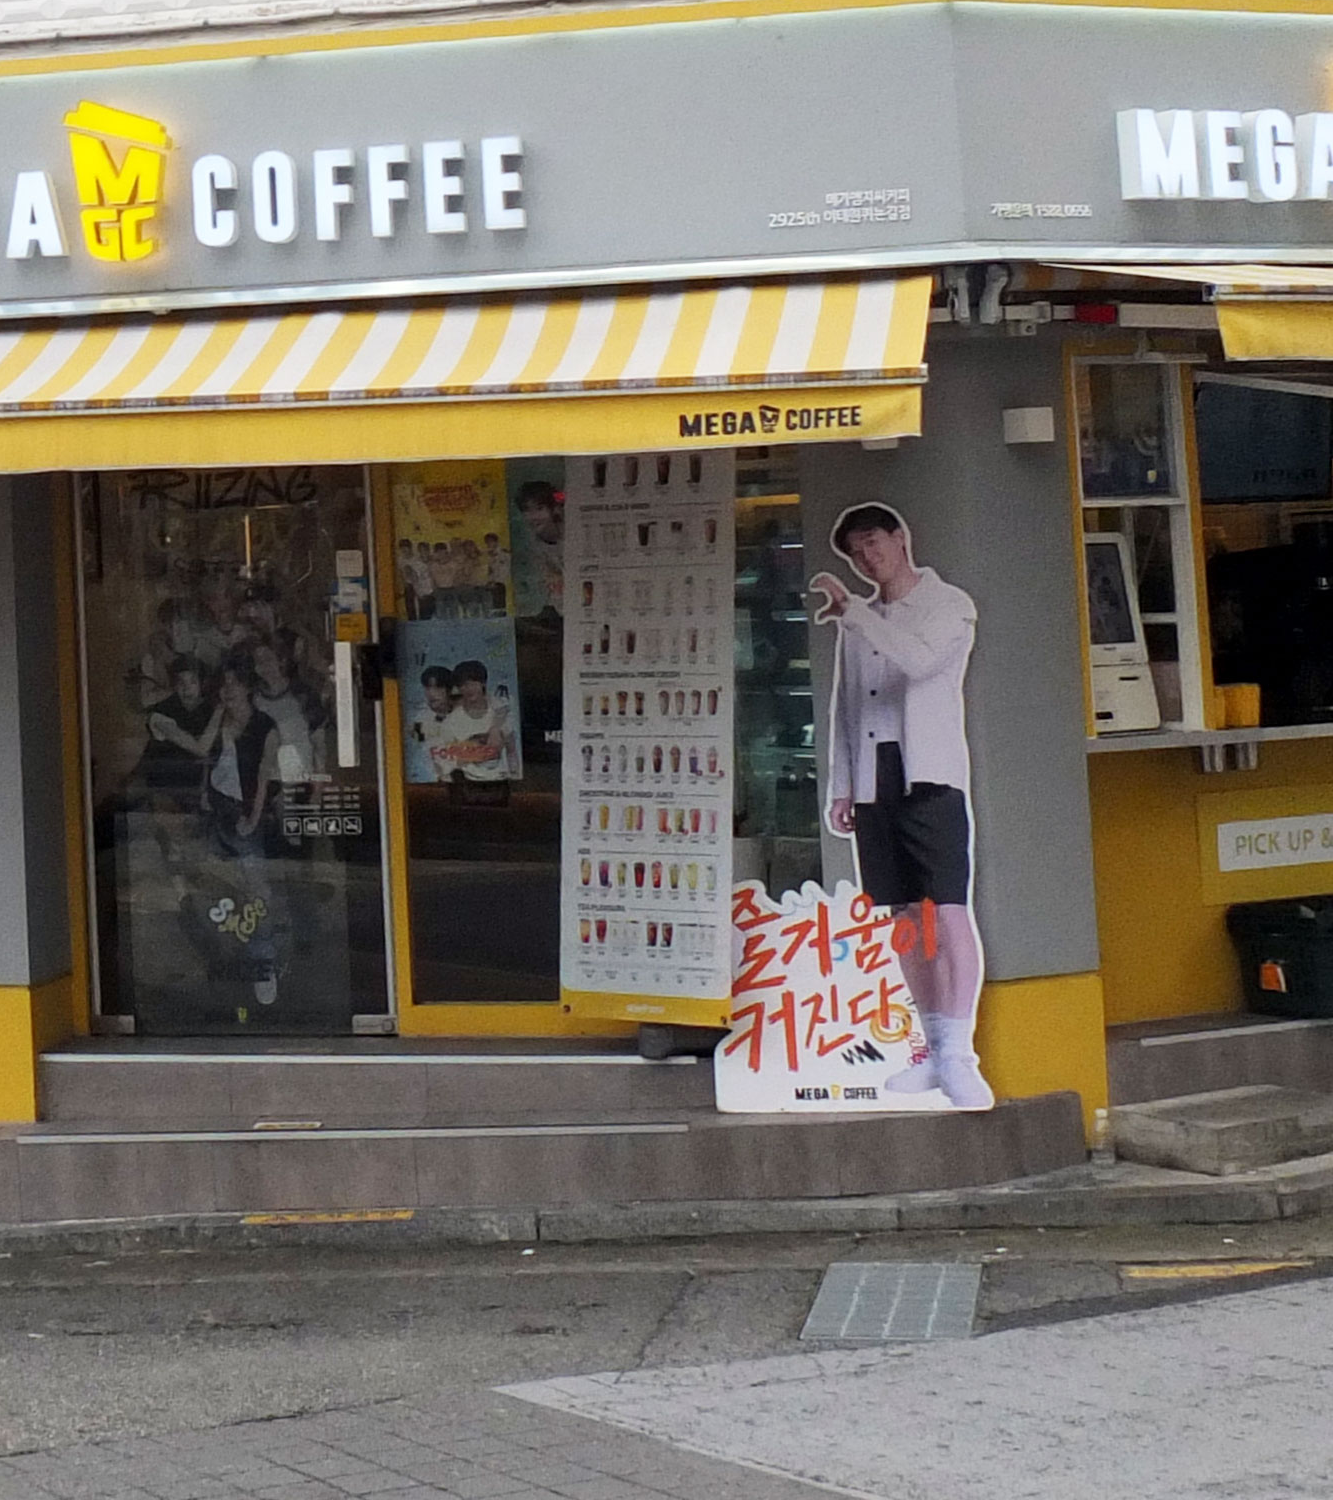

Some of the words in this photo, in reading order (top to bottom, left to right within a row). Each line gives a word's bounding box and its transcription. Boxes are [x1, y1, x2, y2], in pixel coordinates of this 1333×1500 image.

[190, 135, 528, 249] COFFEE
[768, 211, 821, 228] 2925th
[679, 411, 757, 437] MEGA
[785, 405, 862, 431] COFFEE
[1235, 829, 1281, 857] PICK
[1286, 828, 1315, 851] UP
[731, 887, 938, 999] 즐거움이
[724, 977, 906, 1073] 커진다
[794, 1087, 830, 1100] MEGA
[843, 1086, 879, 1100] COFFEE
